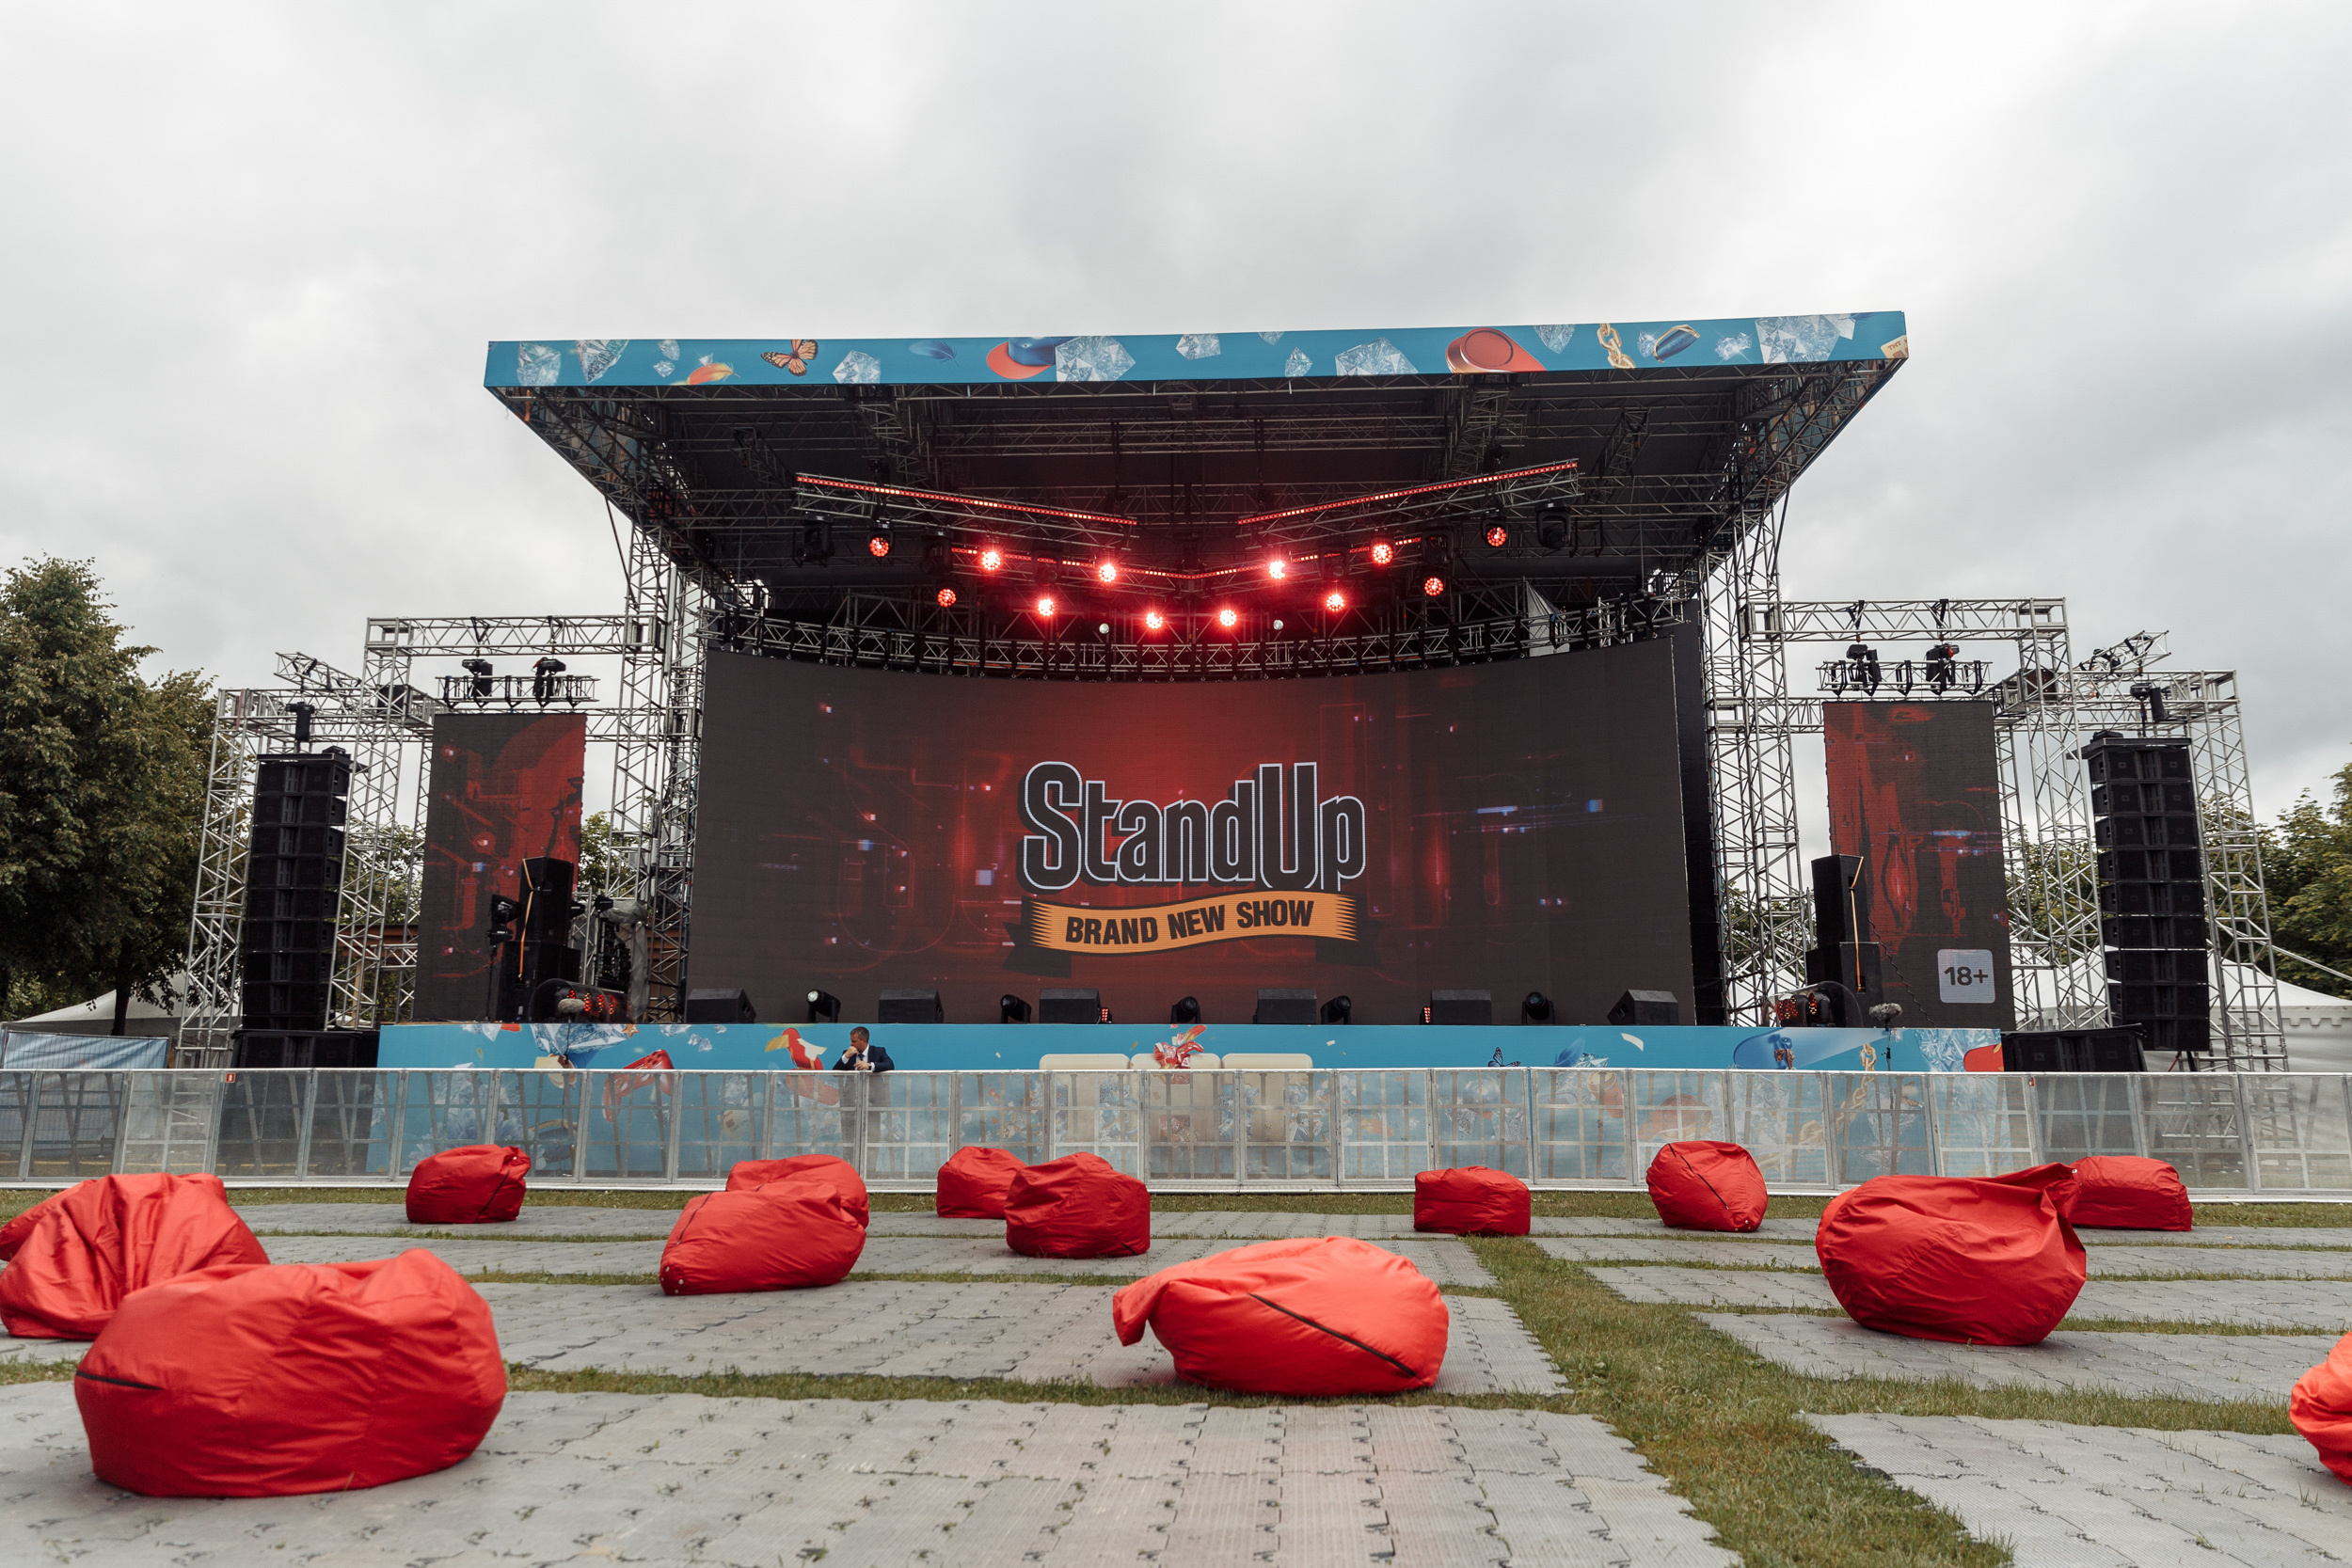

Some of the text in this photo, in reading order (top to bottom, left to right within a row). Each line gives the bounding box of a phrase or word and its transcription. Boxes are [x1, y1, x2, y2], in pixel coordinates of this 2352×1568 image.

[1023, 760, 1366, 892] StandUp
[1065, 899, 1315, 945] BRAND NEW SHOW
[1944, 966, 1989, 986] 18+
